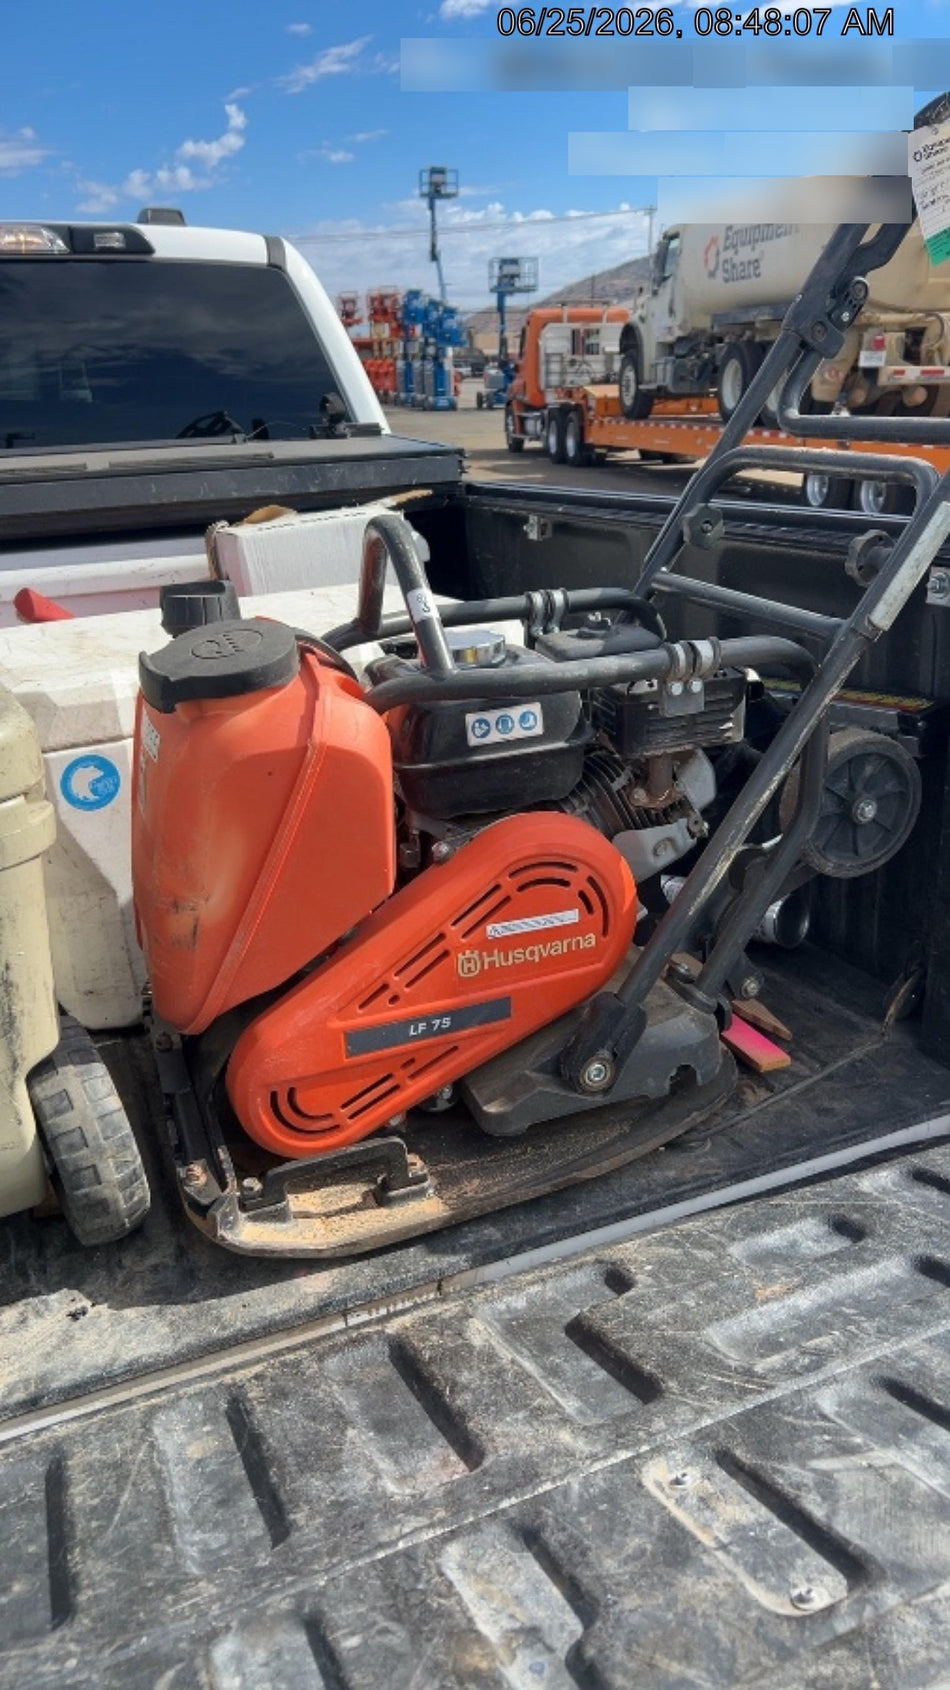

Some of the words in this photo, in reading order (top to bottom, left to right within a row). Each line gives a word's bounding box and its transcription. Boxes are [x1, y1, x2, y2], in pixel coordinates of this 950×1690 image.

[721, 256, 761, 283] Share
[484, 932, 597, 970] Husqvarna
[409, 1022, 427, 1037] LF
[432, 1016, 451, 1032] 75
